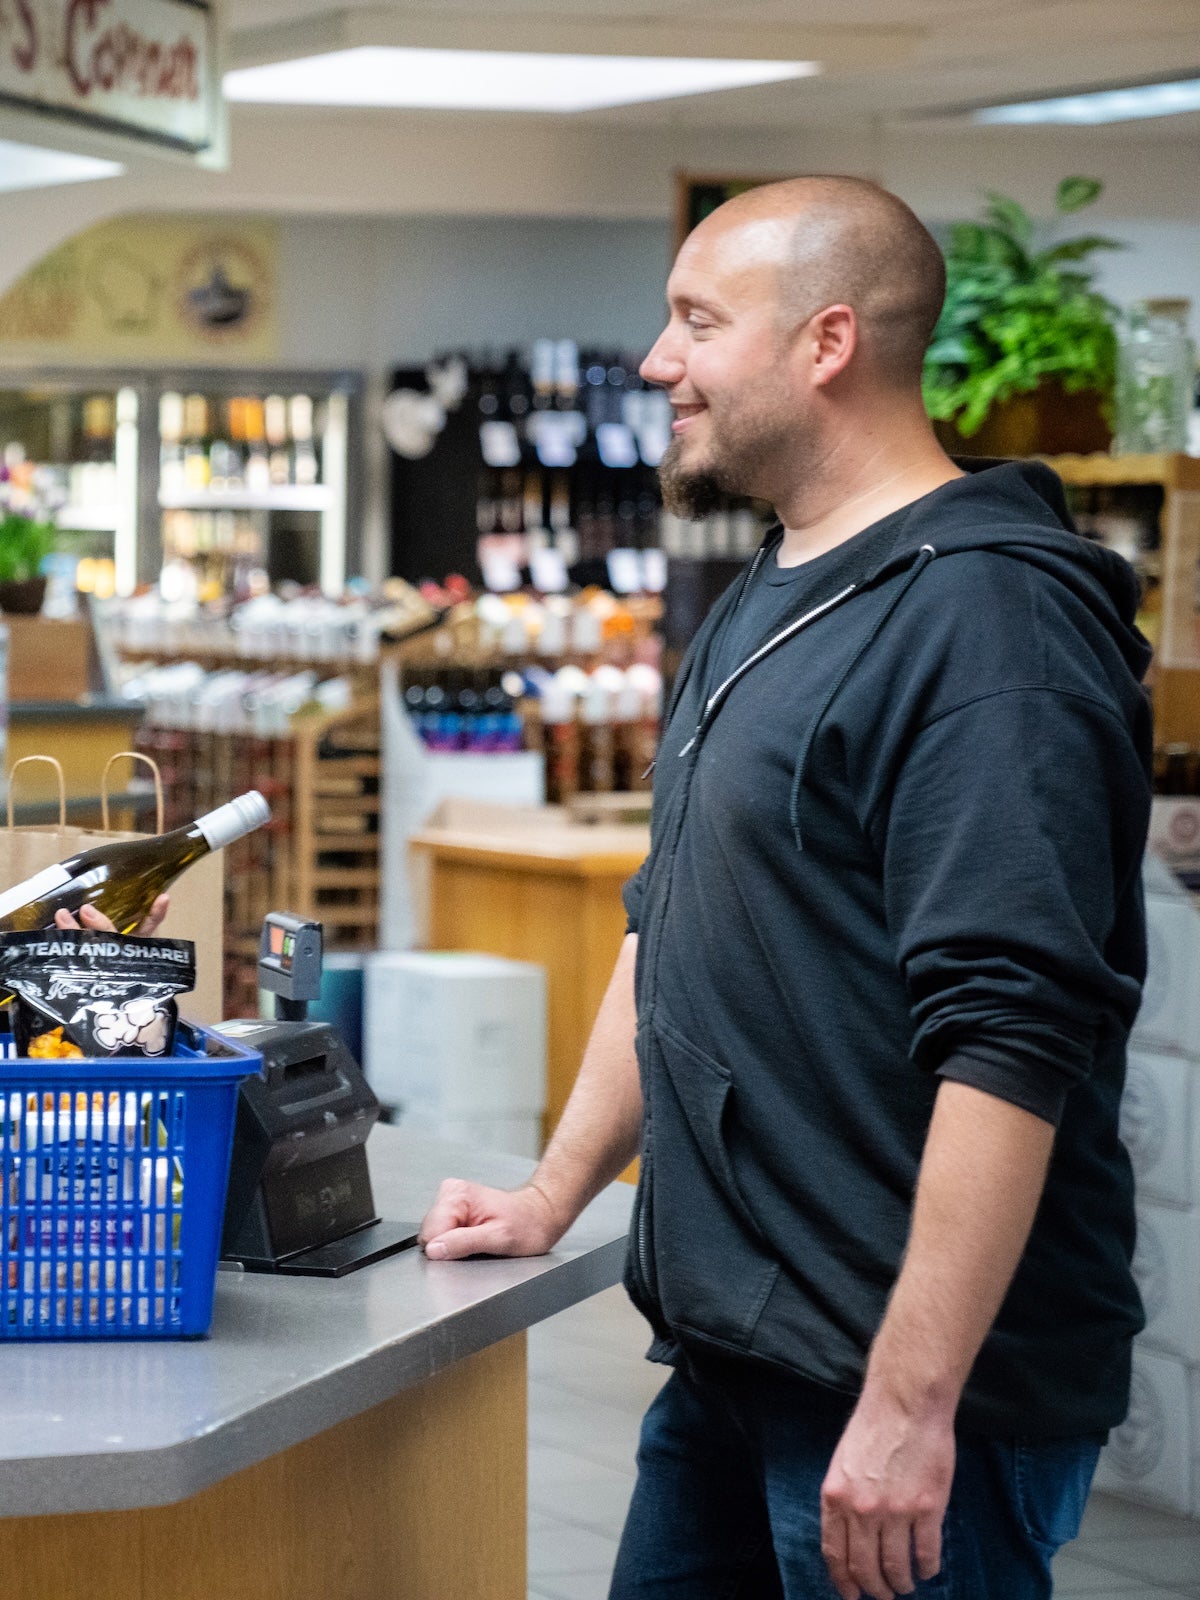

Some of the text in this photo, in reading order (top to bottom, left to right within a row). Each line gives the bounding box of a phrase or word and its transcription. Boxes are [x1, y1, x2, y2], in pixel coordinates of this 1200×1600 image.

[26, 941, 75, 957] TEAR
[78, 942, 120, 957] AND
[121, 944, 190, 963] SHARE!
